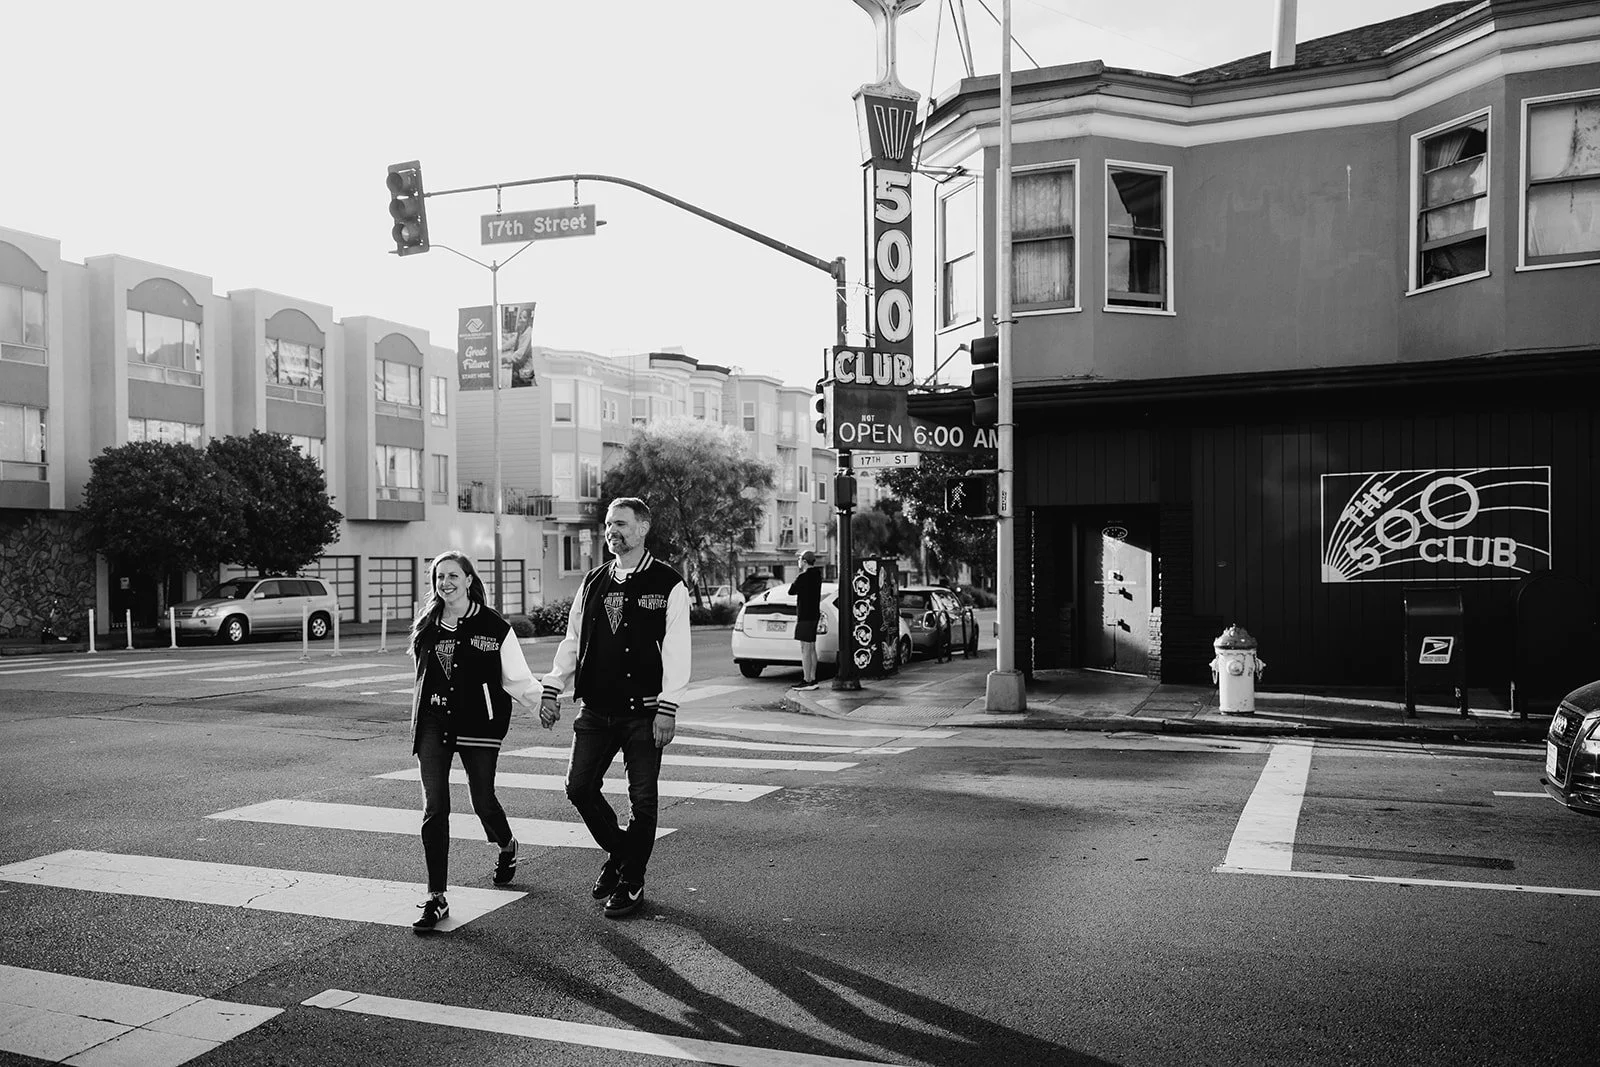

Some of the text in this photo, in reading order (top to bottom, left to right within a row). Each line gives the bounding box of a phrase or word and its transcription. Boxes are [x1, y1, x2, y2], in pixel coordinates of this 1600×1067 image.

[487, 213, 587, 240] 17th Street
[875, 168, 912, 343] 500
[834, 351, 914, 386] CLUB
[839, 422, 902, 444] OPEN
[914, 425, 964, 447] 6:00
[861, 455, 908, 465] 17TH ST
[1341, 481, 1394, 527] THE
[1419, 535, 1517, 567] CLUB
